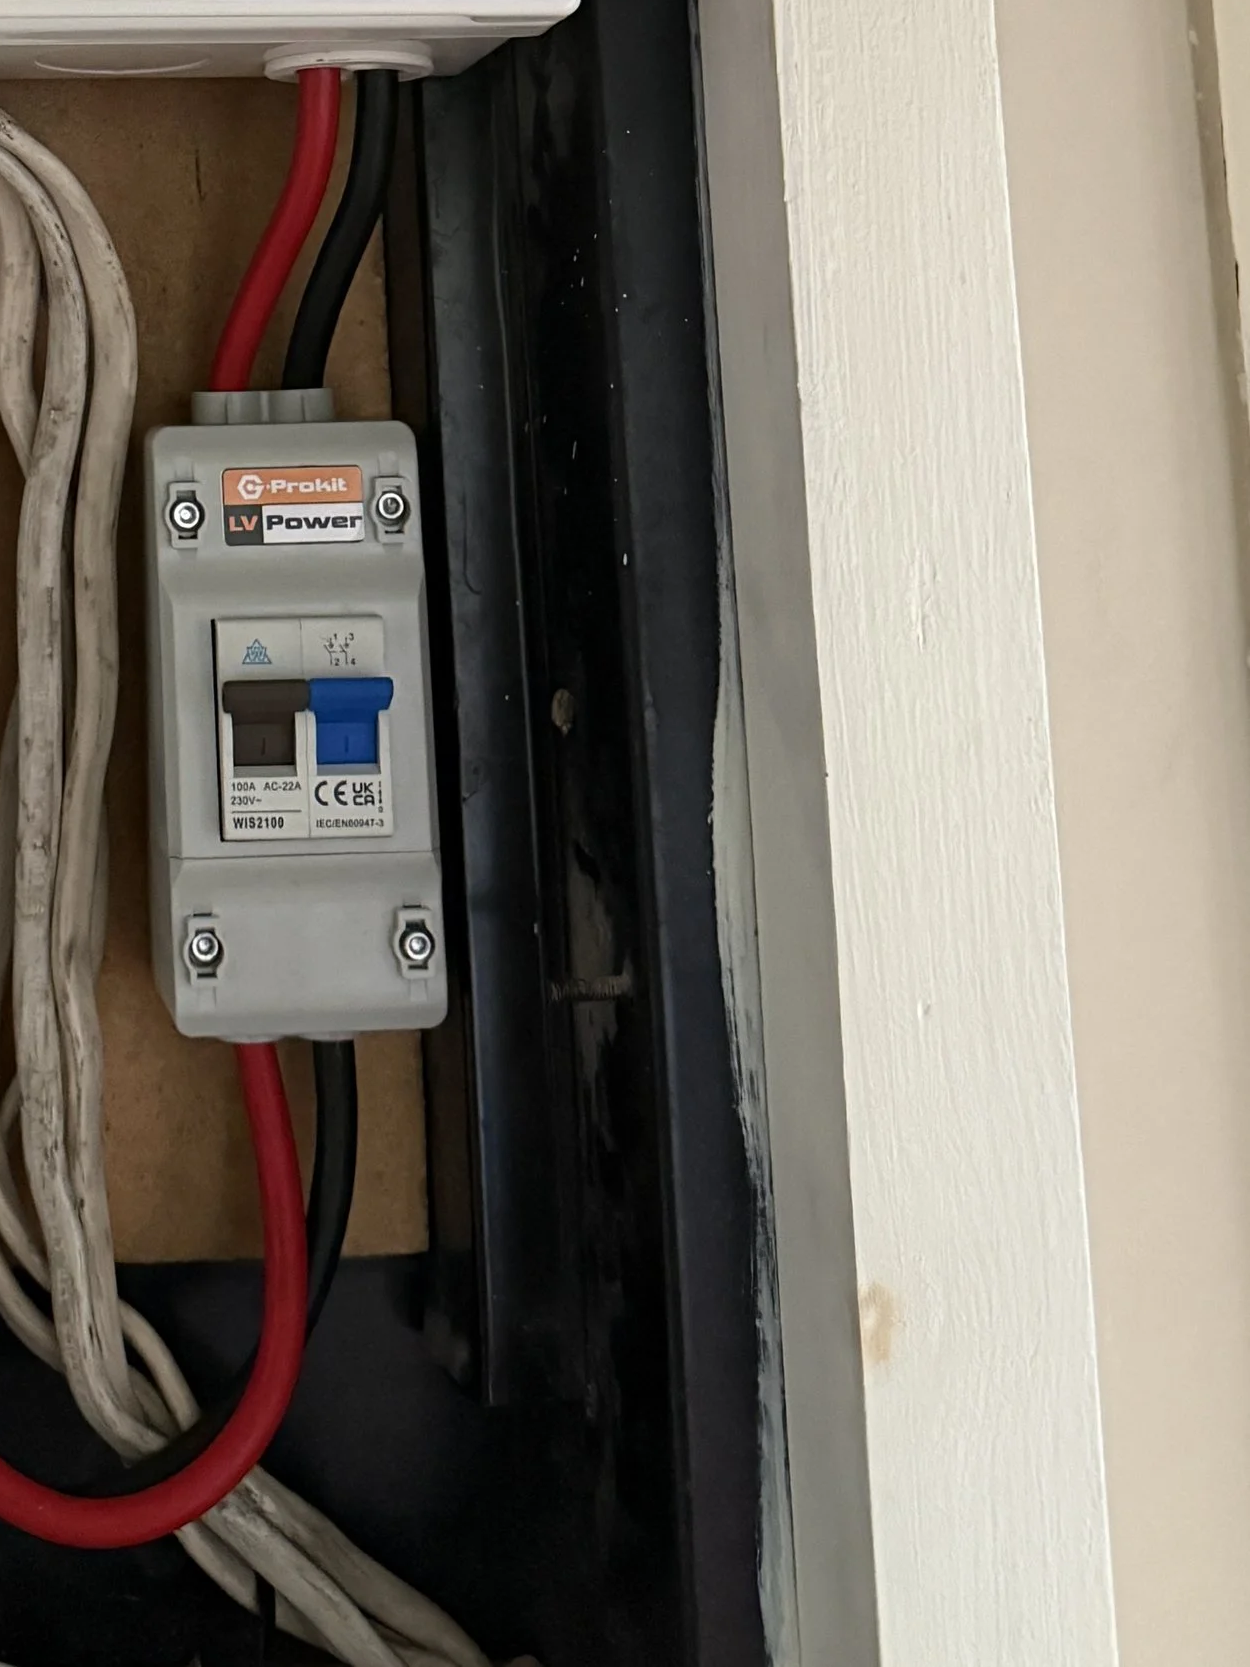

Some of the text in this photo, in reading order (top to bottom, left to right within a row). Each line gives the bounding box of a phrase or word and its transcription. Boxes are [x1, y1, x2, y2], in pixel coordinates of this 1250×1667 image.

[228, 515, 363, 532] LV Power
[232, 782, 302, 792] 100A AC-22A
[315, 780, 348, 806] CE
[352, 782, 374, 794] UK
[353, 795, 375, 806] CA
[233, 817, 284, 829] WIS2100
